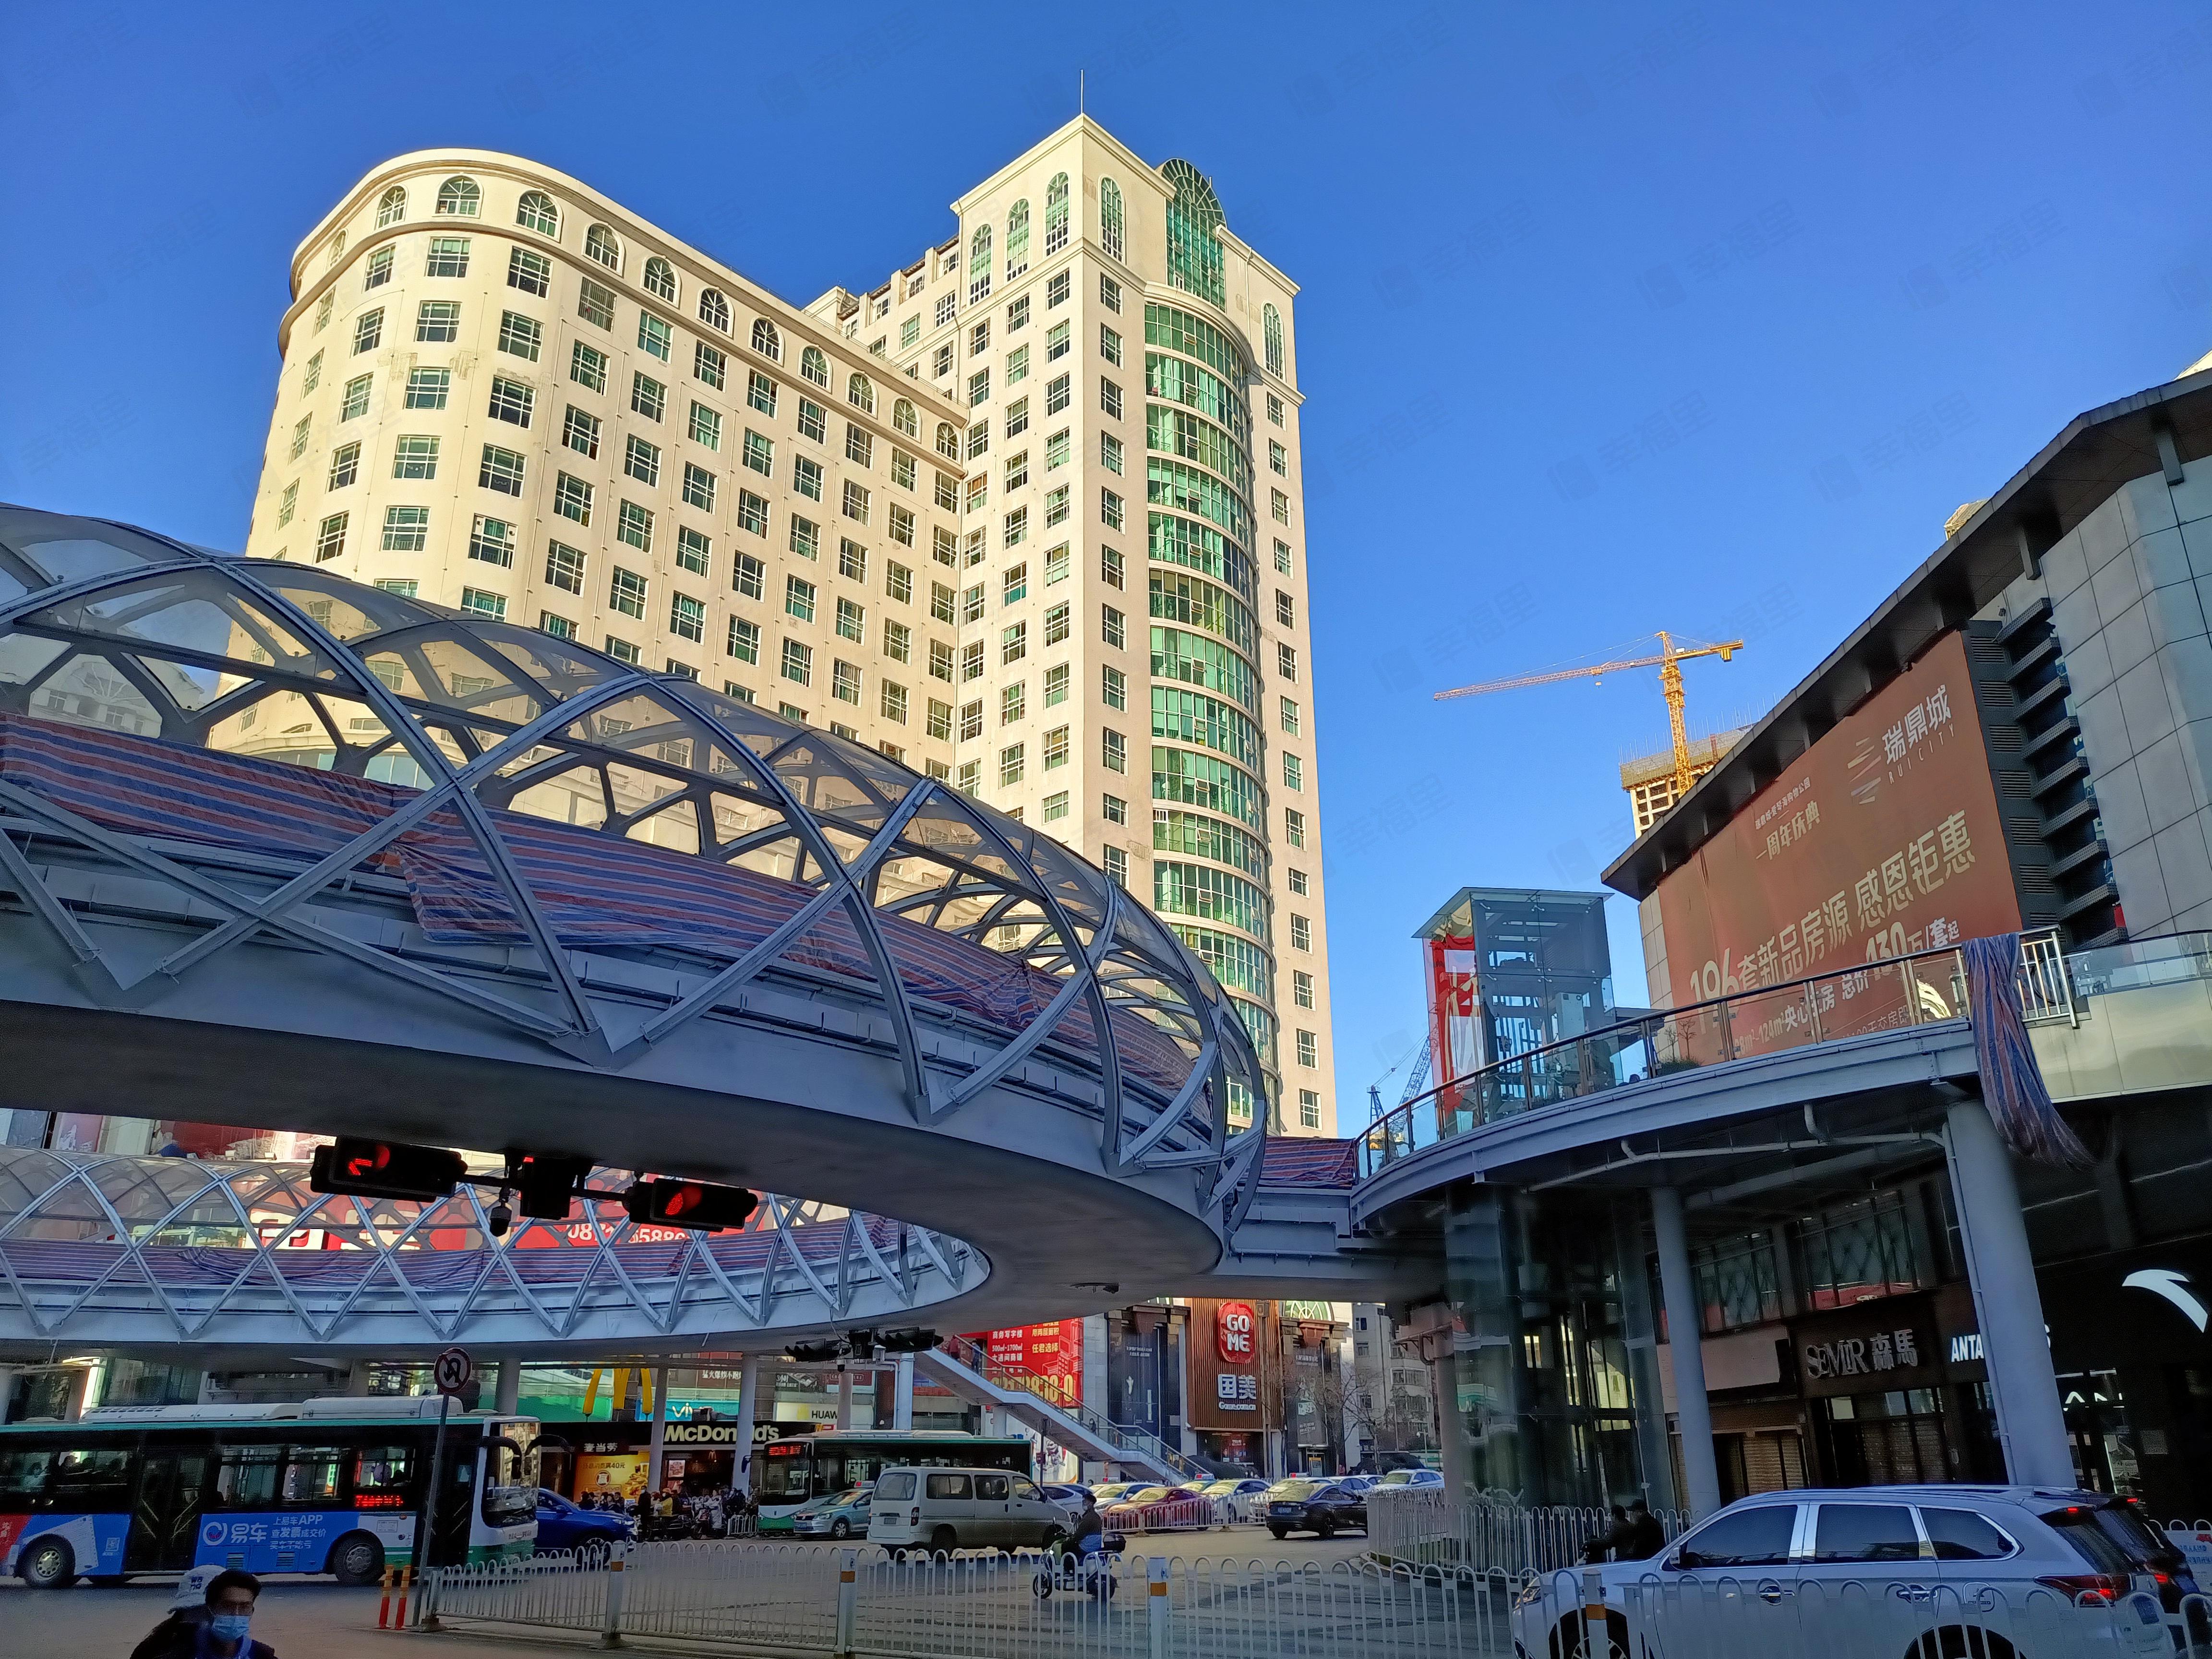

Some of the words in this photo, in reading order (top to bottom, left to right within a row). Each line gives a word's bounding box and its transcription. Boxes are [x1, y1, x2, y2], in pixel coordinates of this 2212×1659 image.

[1882, 684, 1951, 764] 瑞鼎城
[1755, 800, 1820, 860] 一周年庆典
[1855, 809, 1976, 933] 感恩钜惠
[1226, 1314, 1250, 1332] GO
[1032, 1343, 1058, 1353] 任君选择
[1227, 1333, 1250, 1352] ME
[1951, 1334, 1984, 1363] ANTA
[1218, 1374, 1256, 1400] 国美
[584, 1442, 618, 1452] 麦当劳
[230, 1523, 268, 1543] 易车
